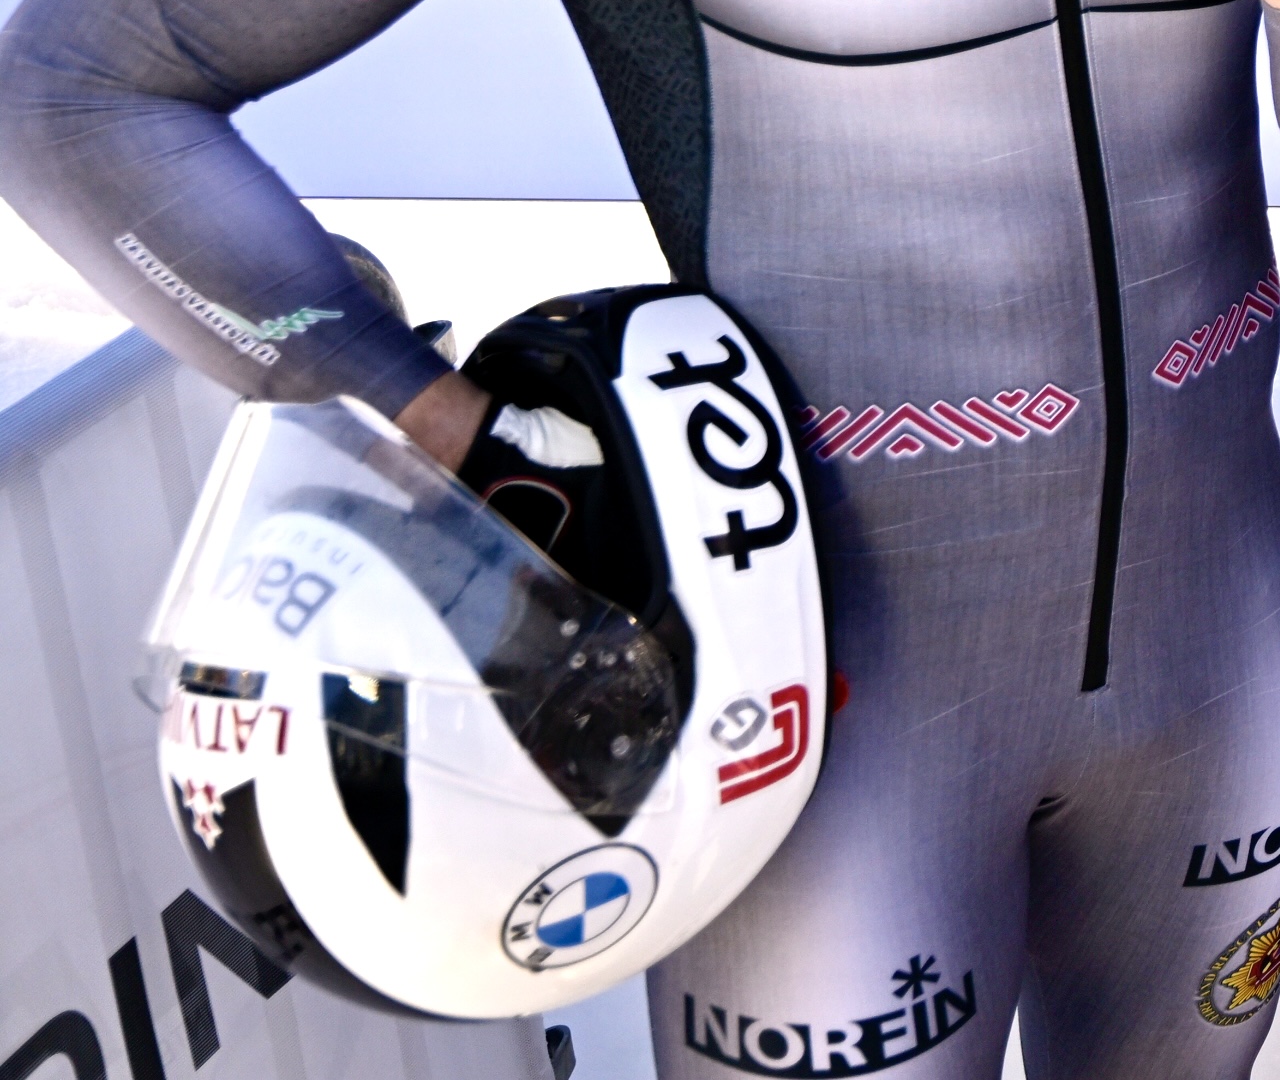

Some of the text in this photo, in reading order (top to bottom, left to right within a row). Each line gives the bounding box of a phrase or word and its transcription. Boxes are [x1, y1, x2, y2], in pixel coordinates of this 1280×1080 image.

[647, 334, 800, 572] tet
[168, 700, 292, 756] LATV
[684, 954, 977, 1078] NORFIN
